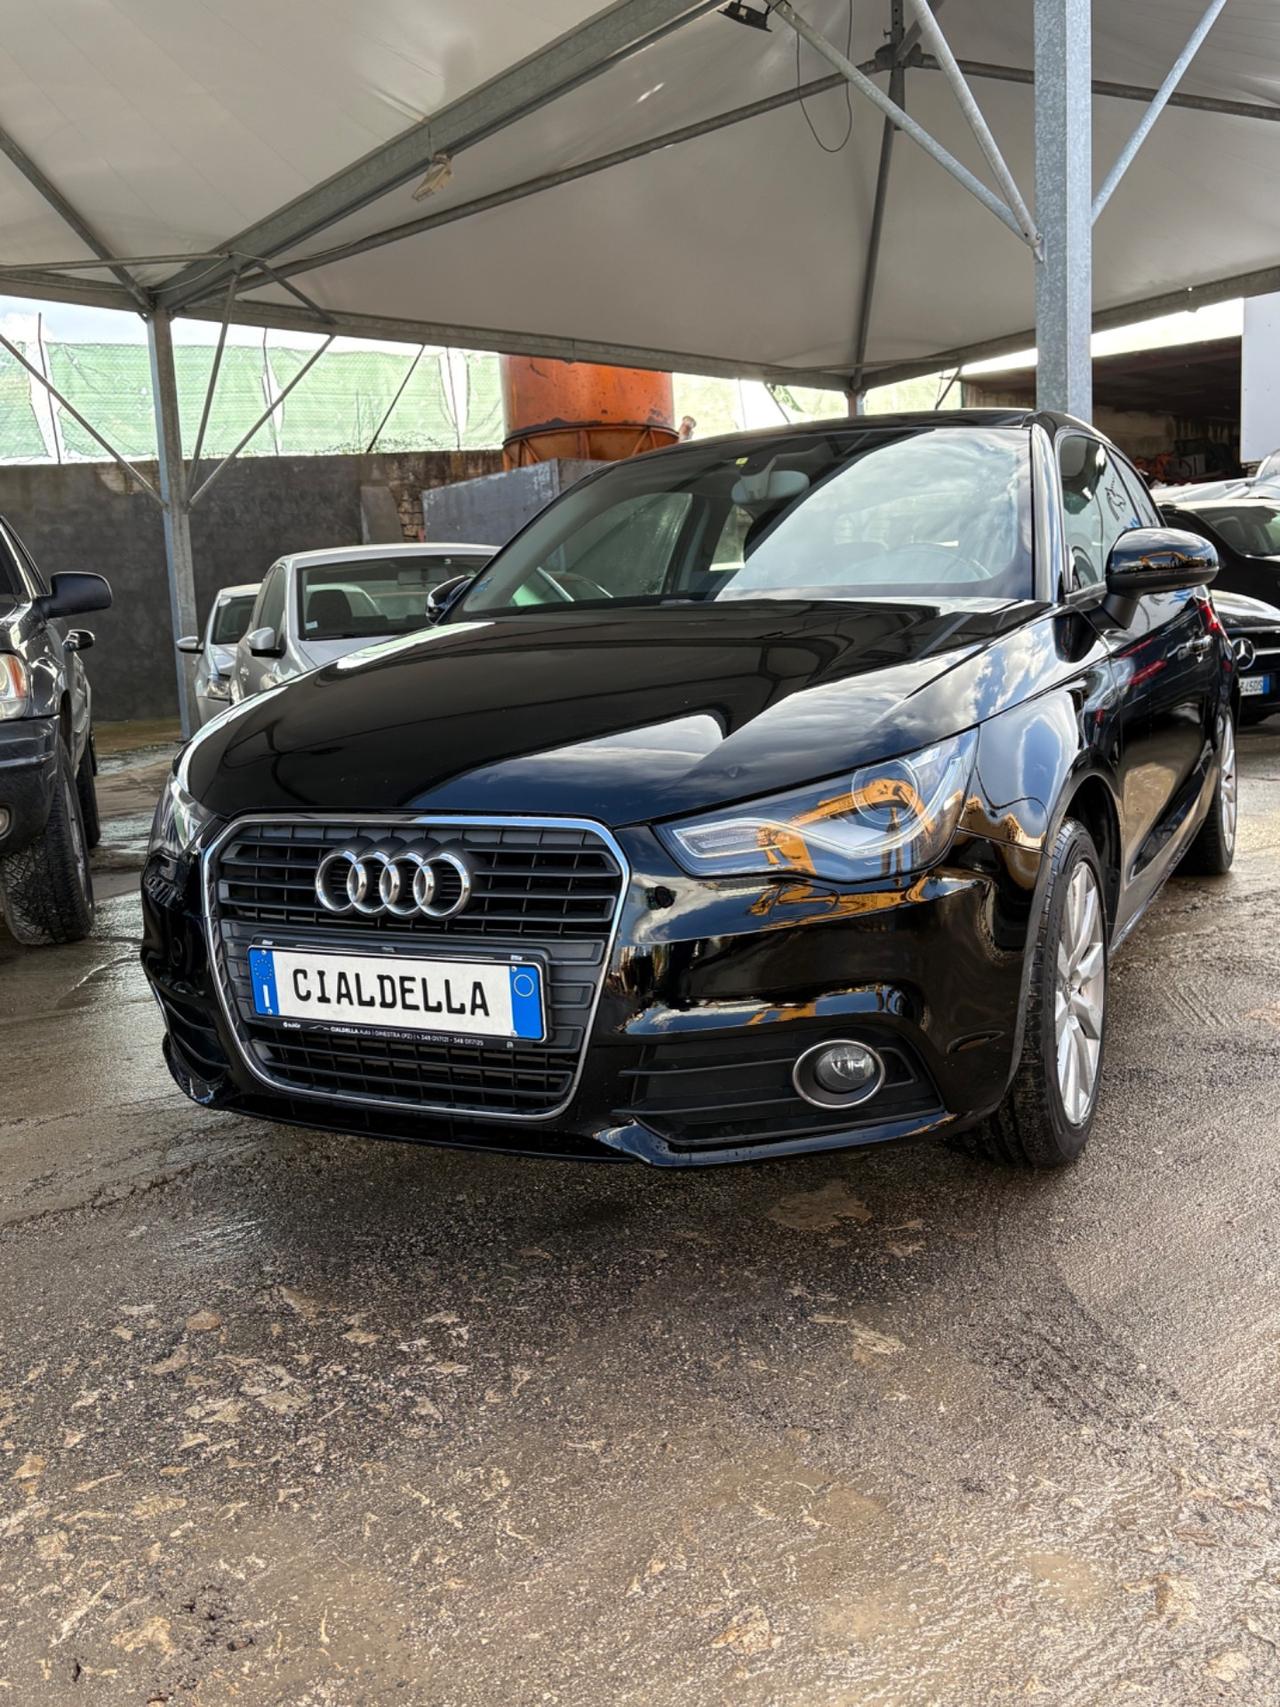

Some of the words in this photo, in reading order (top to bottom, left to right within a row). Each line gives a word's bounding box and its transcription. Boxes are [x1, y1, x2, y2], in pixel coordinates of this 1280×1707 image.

[262, 984, 270, 1008] I
[292, 968, 490, 1017] CIALDELLA
[330, 1025, 359, 1034] CIALDELLA
